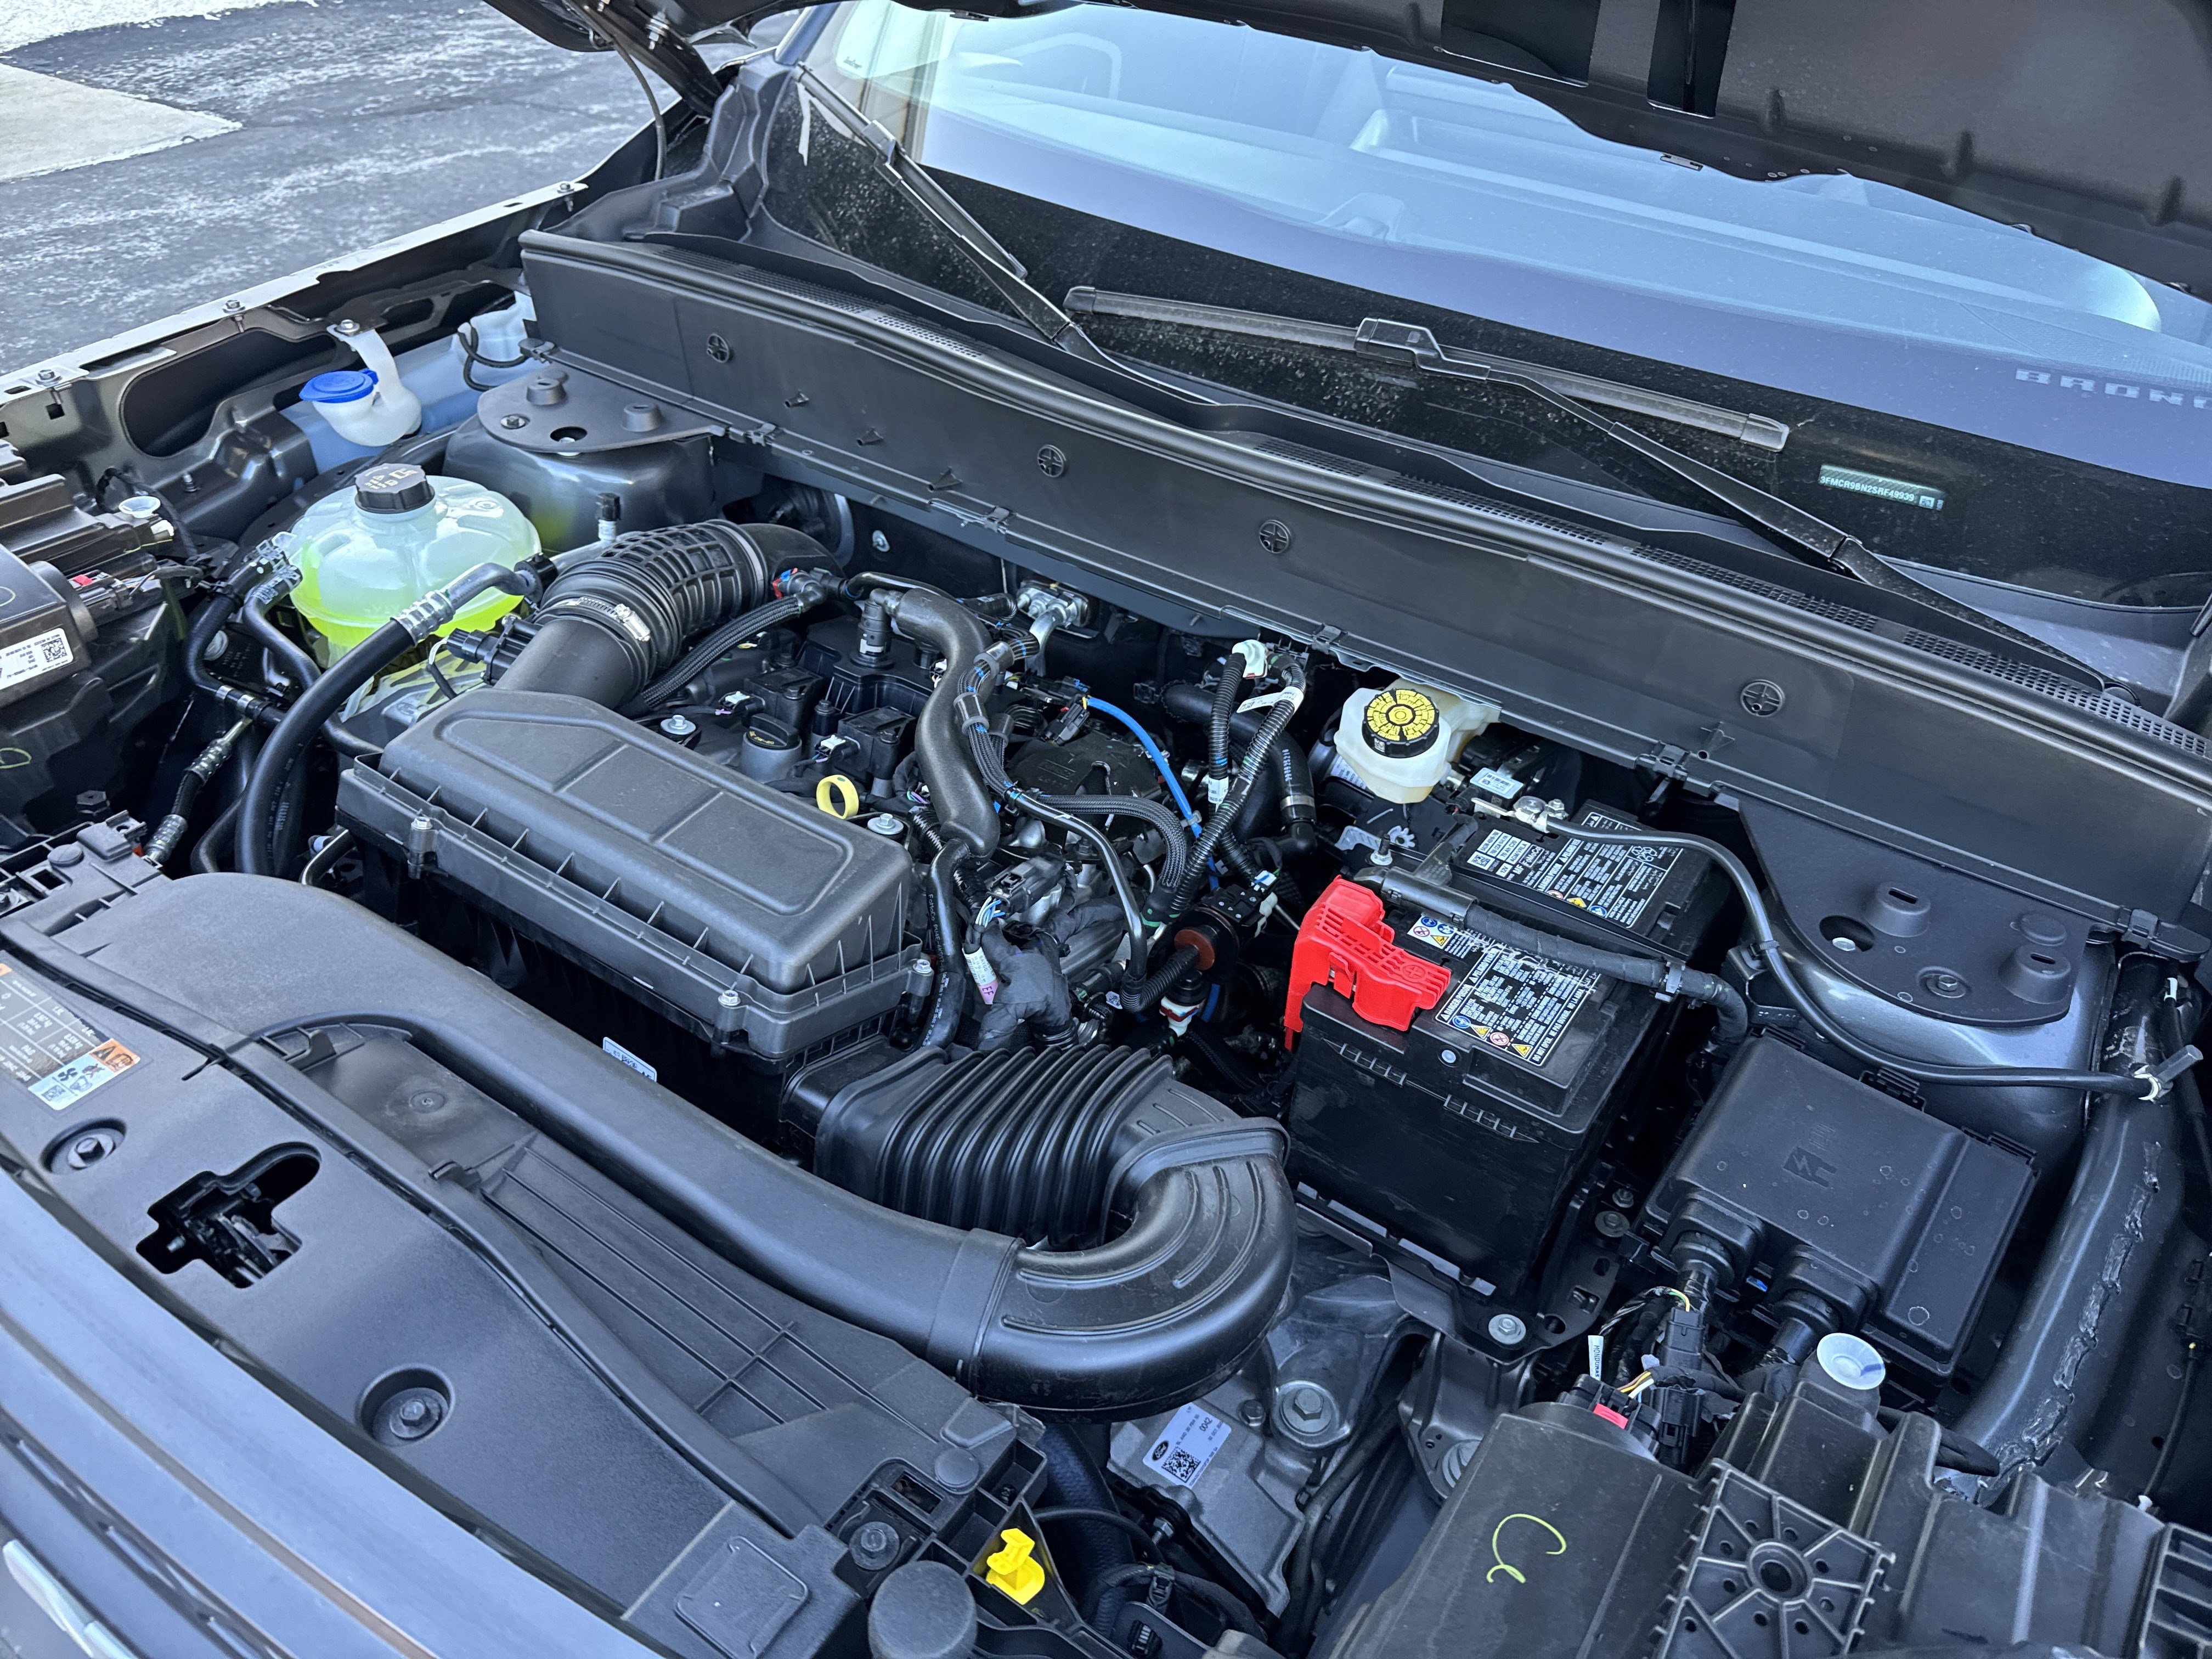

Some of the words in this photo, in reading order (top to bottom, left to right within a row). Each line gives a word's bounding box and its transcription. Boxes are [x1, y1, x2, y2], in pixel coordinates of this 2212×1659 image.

[1521, 845, 1541, 866] FoMoCo
[1198, 1416, 1213, 1432] 0042
[1151, 1442, 1169, 1458] Ford
